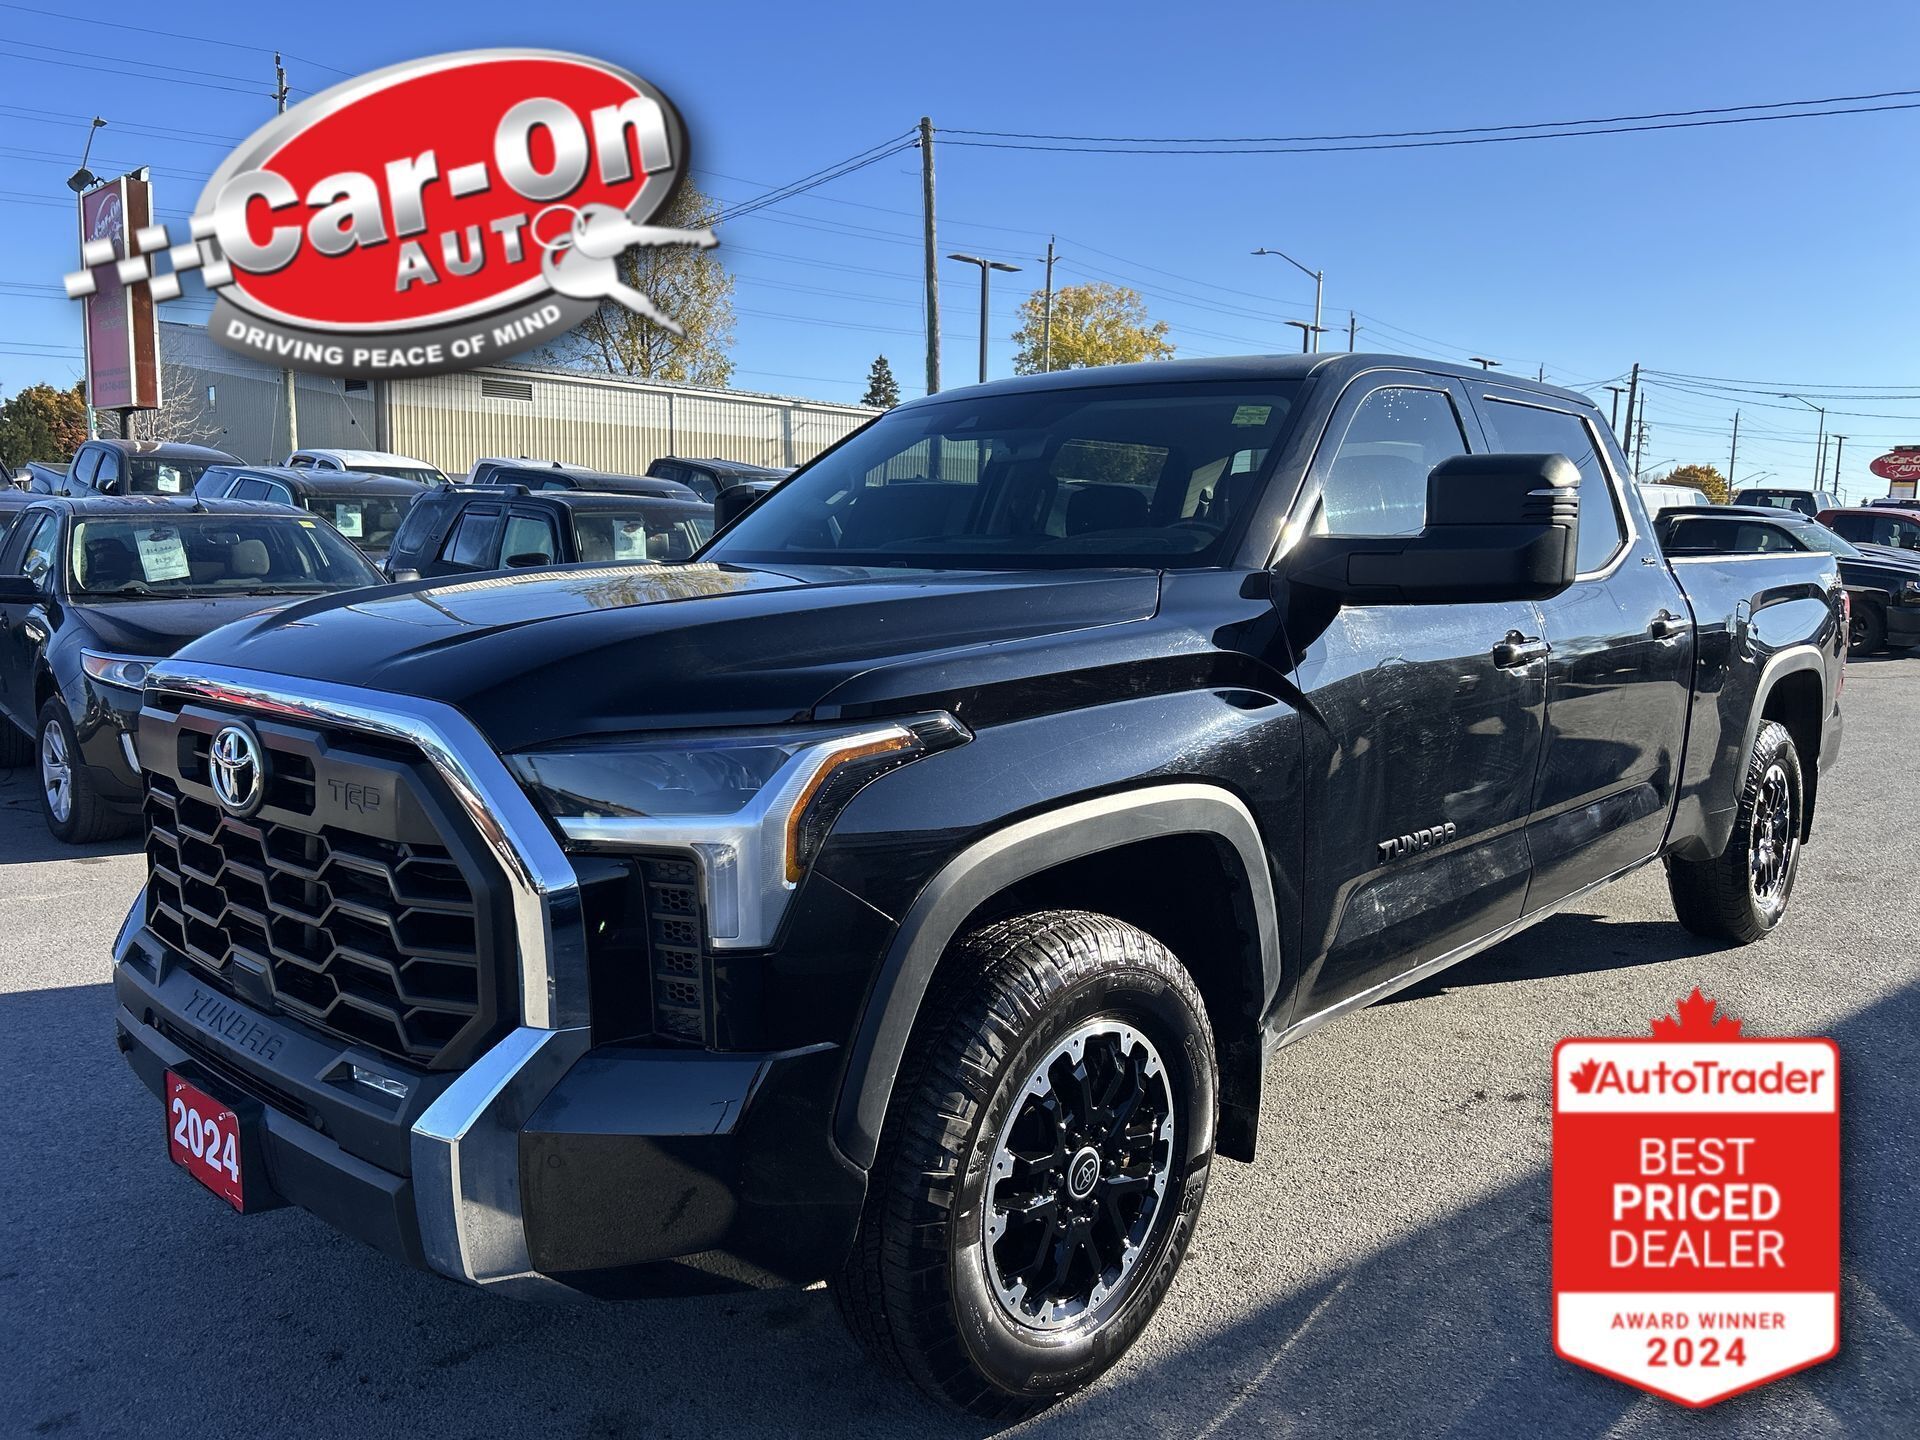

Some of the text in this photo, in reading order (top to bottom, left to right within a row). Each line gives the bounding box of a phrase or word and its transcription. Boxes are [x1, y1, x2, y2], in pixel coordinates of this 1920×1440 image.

[327, 778, 381, 816] TRD
[1377, 821, 1457, 864] TUNDRA
[184, 988, 288, 1062] TUNDRA
[172, 1097, 240, 1184] 2024
